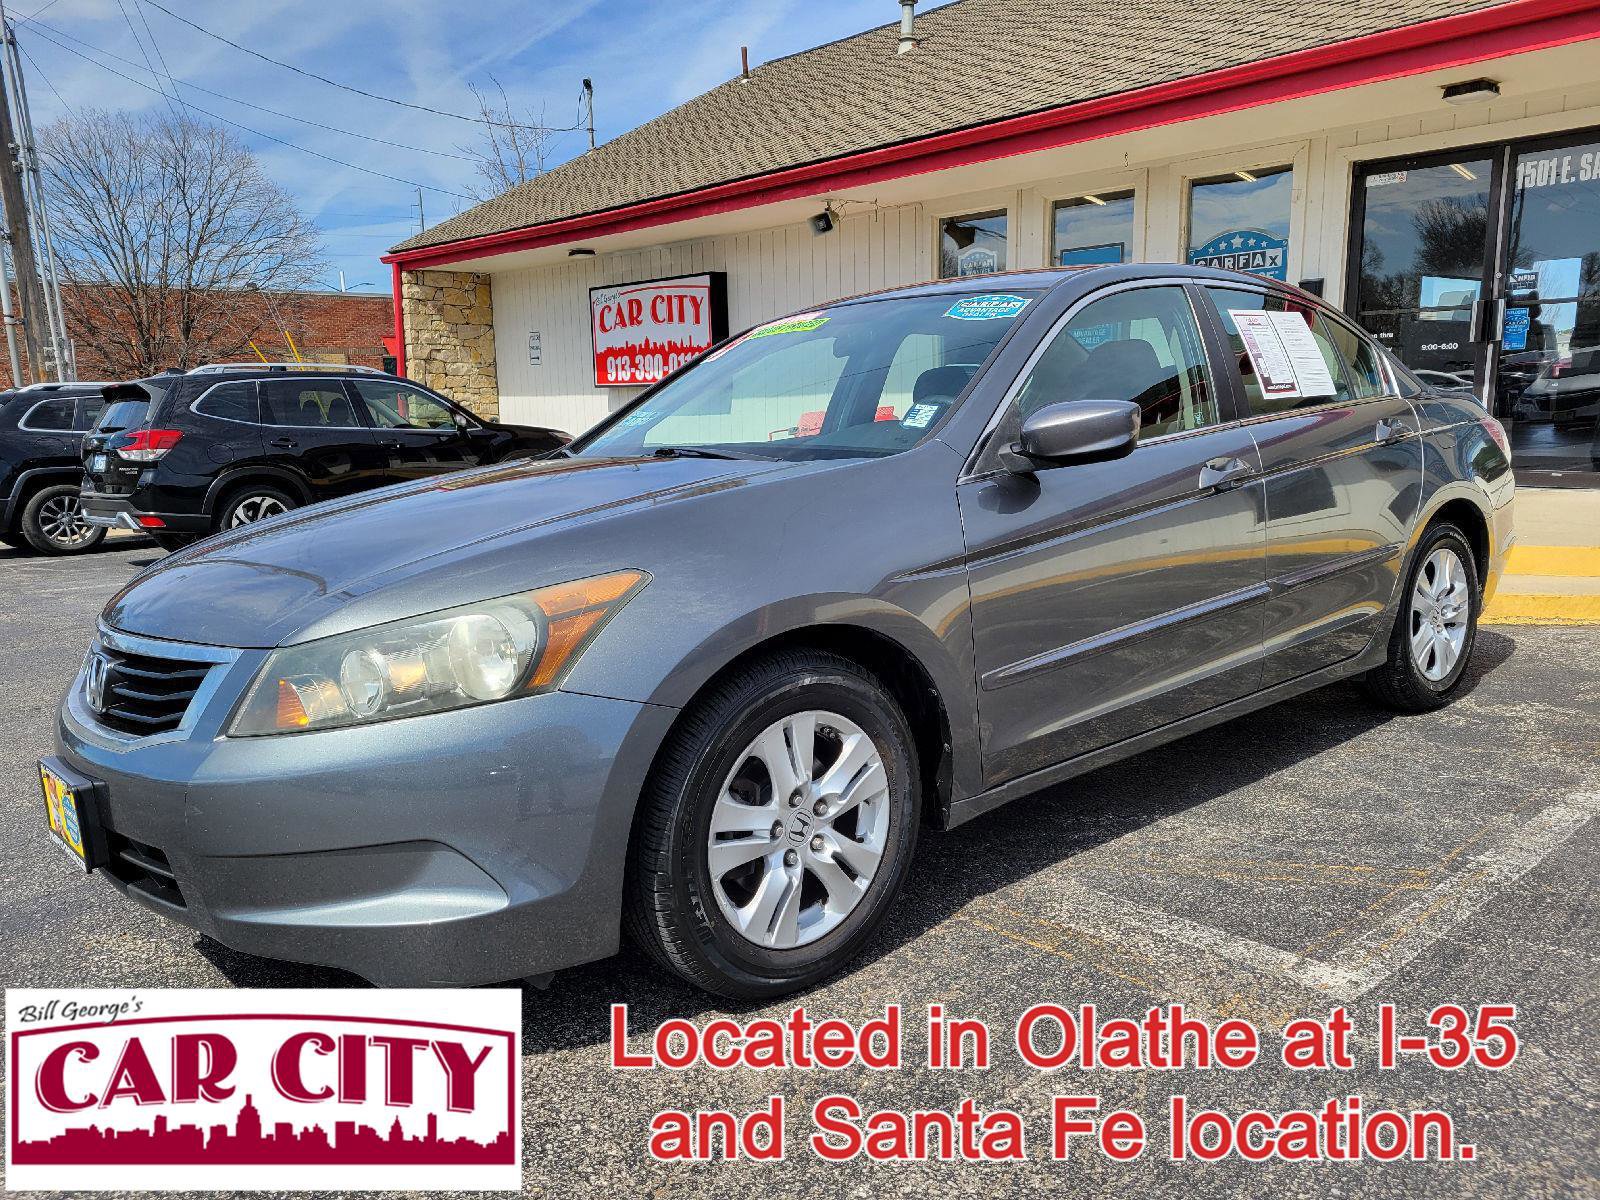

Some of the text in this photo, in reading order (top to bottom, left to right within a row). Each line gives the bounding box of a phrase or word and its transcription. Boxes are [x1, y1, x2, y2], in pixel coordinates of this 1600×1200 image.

[1516, 158, 1557, 189] 1501
[1561, 155, 1576, 183] E.
[599, 294, 704, 334] CAR CITY
[1421, 342, 1459, 351] 9:00-6:00
